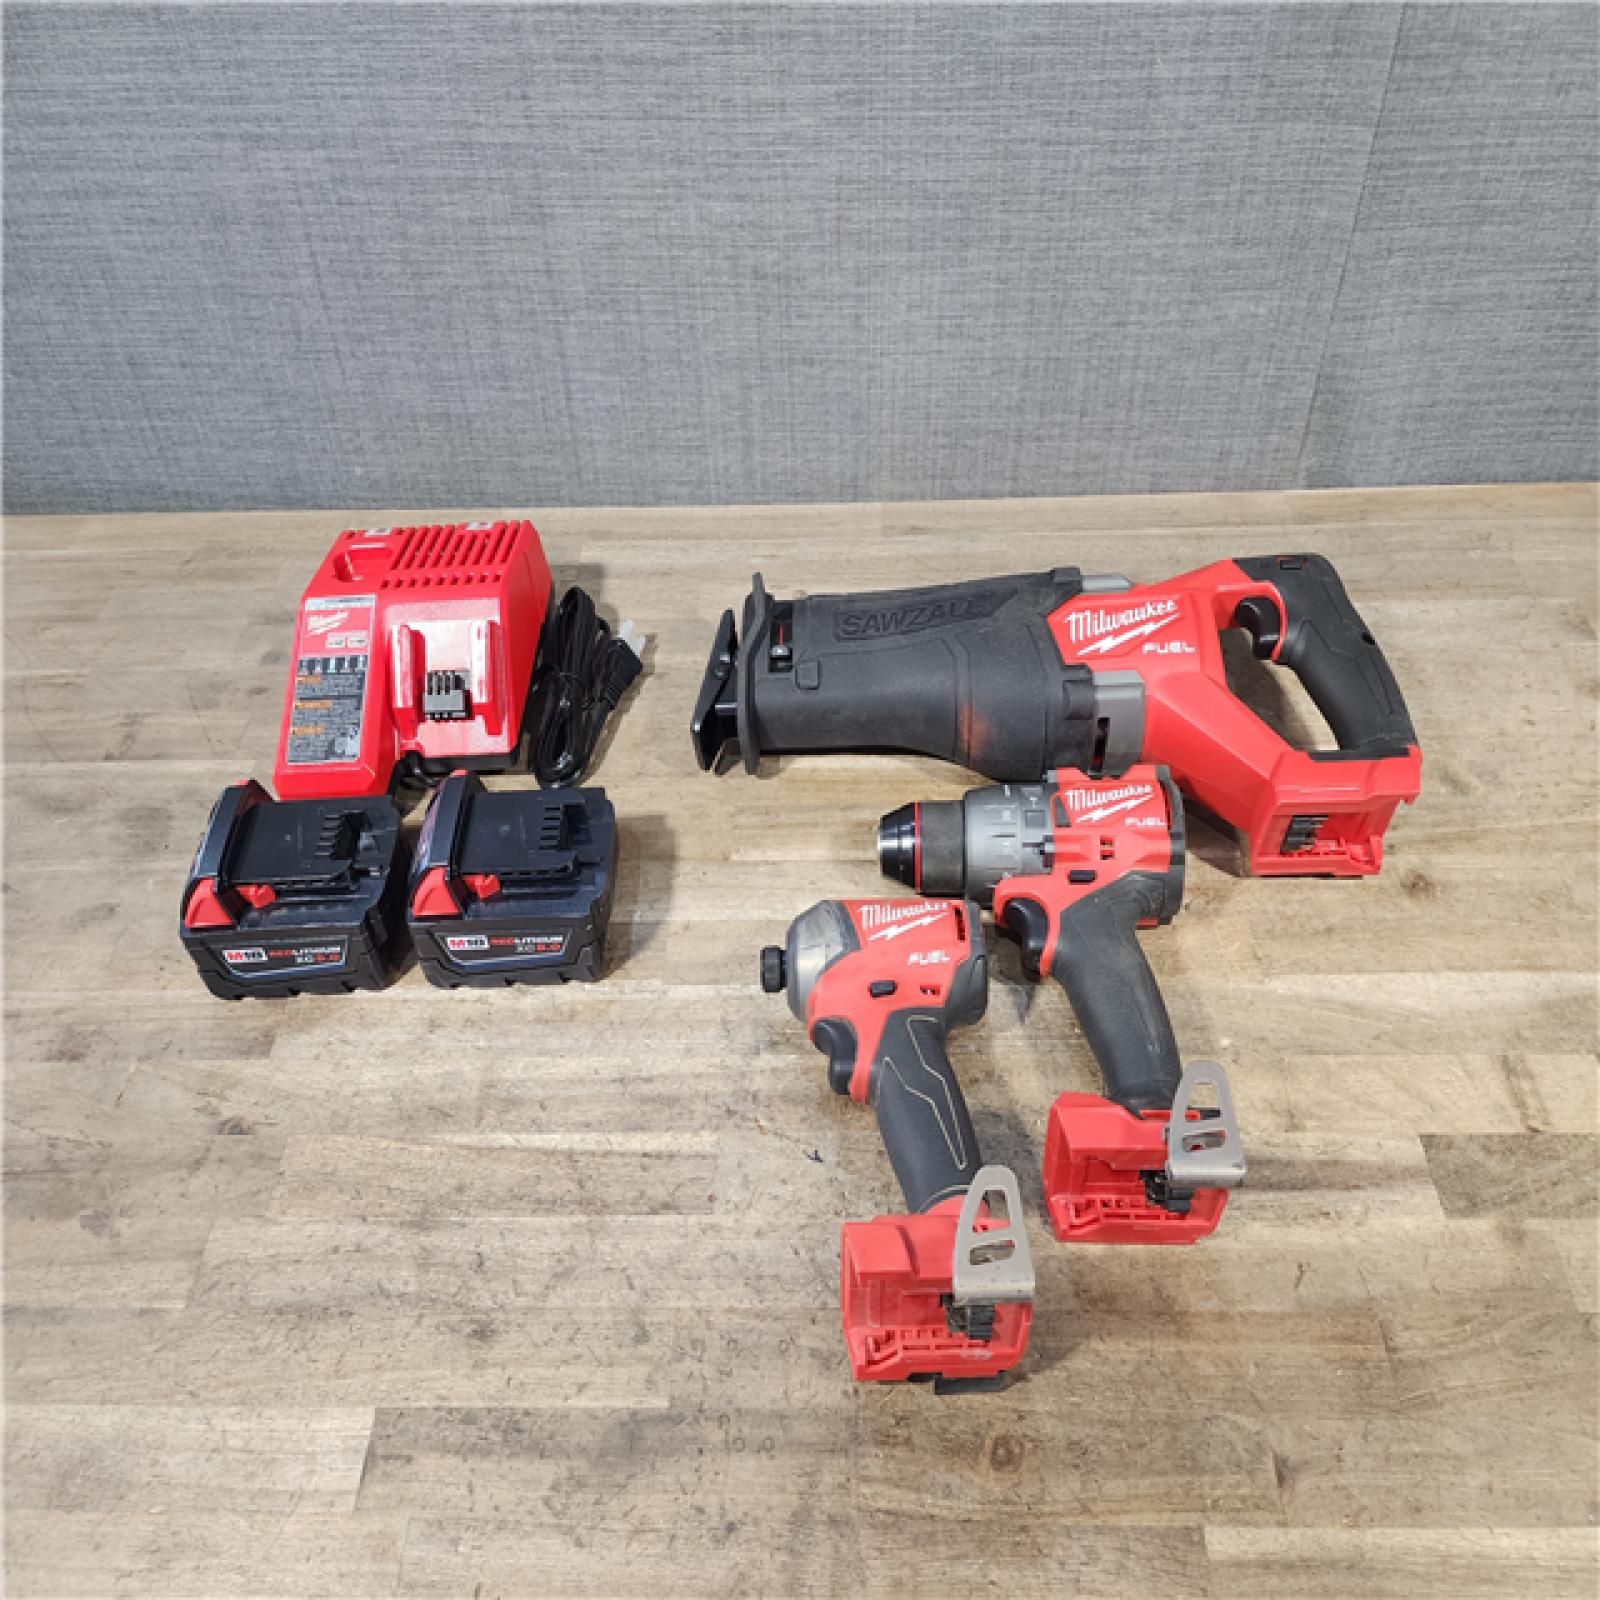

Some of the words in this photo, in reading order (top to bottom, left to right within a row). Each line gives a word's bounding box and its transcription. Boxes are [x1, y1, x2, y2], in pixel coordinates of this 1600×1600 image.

[842, 599, 984, 635] SAWZALL
[1063, 599, 1178, 643] Milwaukee
[1142, 641, 1196, 655] FUEL
[1064, 784, 1153, 811] Milwaukee
[1124, 816, 1166, 826] FUEL
[858, 900, 948, 930] Milwaukee
[907, 949, 950, 966] FUEL
